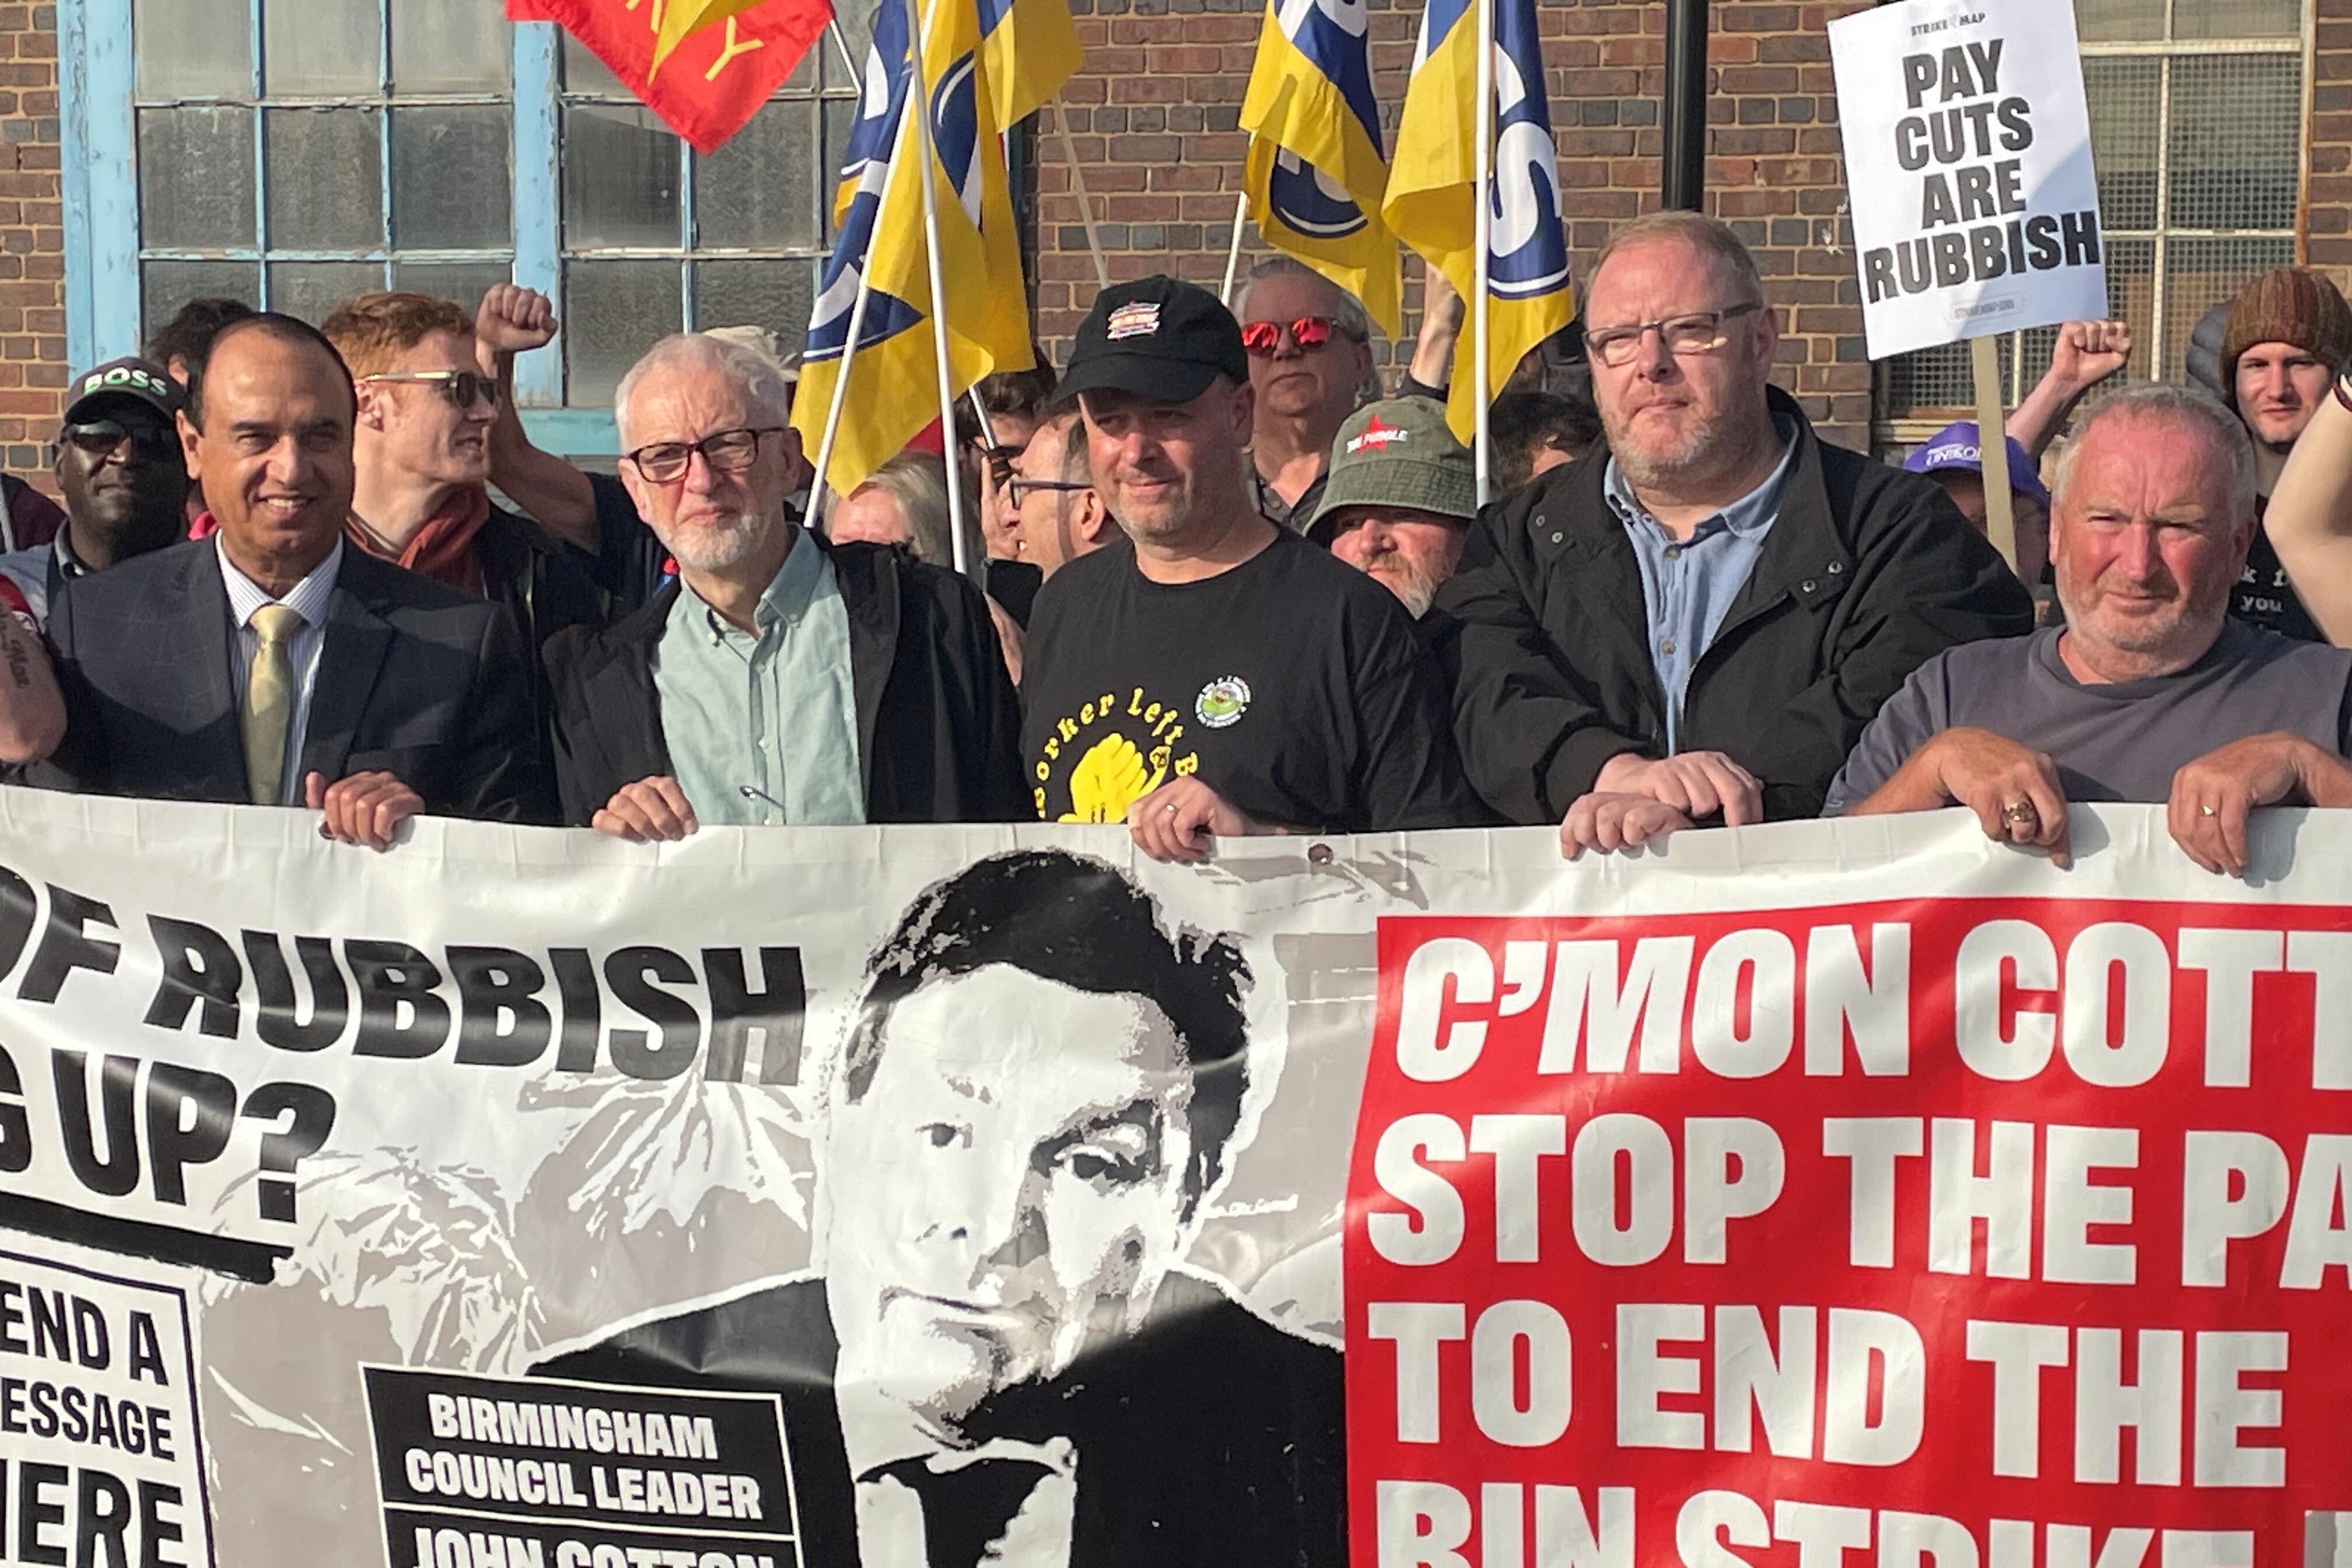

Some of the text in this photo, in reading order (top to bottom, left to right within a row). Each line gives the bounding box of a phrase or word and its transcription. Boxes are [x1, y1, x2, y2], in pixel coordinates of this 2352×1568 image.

[1902, 38, 2004, 109] PAY
[1895, 97, 2033, 171] CUTS
[1922, 158, 2026, 230] ARE
[1863, 210, 2100, 303] RUBBISH
[84, 367, 167, 397] BOSS
[2240, 595, 2283, 612] you
[144, 914, 806, 1086] RUBBISH
[1396, 923, 1911, 1083] C'MON
[51, 1048, 337, 1224] UP?
[1367, 1113, 1785, 1266] STOP
[1823, 1116, 2139, 1284] THE
[130, 1310, 169, 1386] A
[428, 1393, 718, 1460] BIRMINGHAM
[1368, 1299, 2289, 1487] TO END THE
[0, 1458, 187, 1568] ERE
[405, 1448, 763, 1520] COUNCIL LEADER
